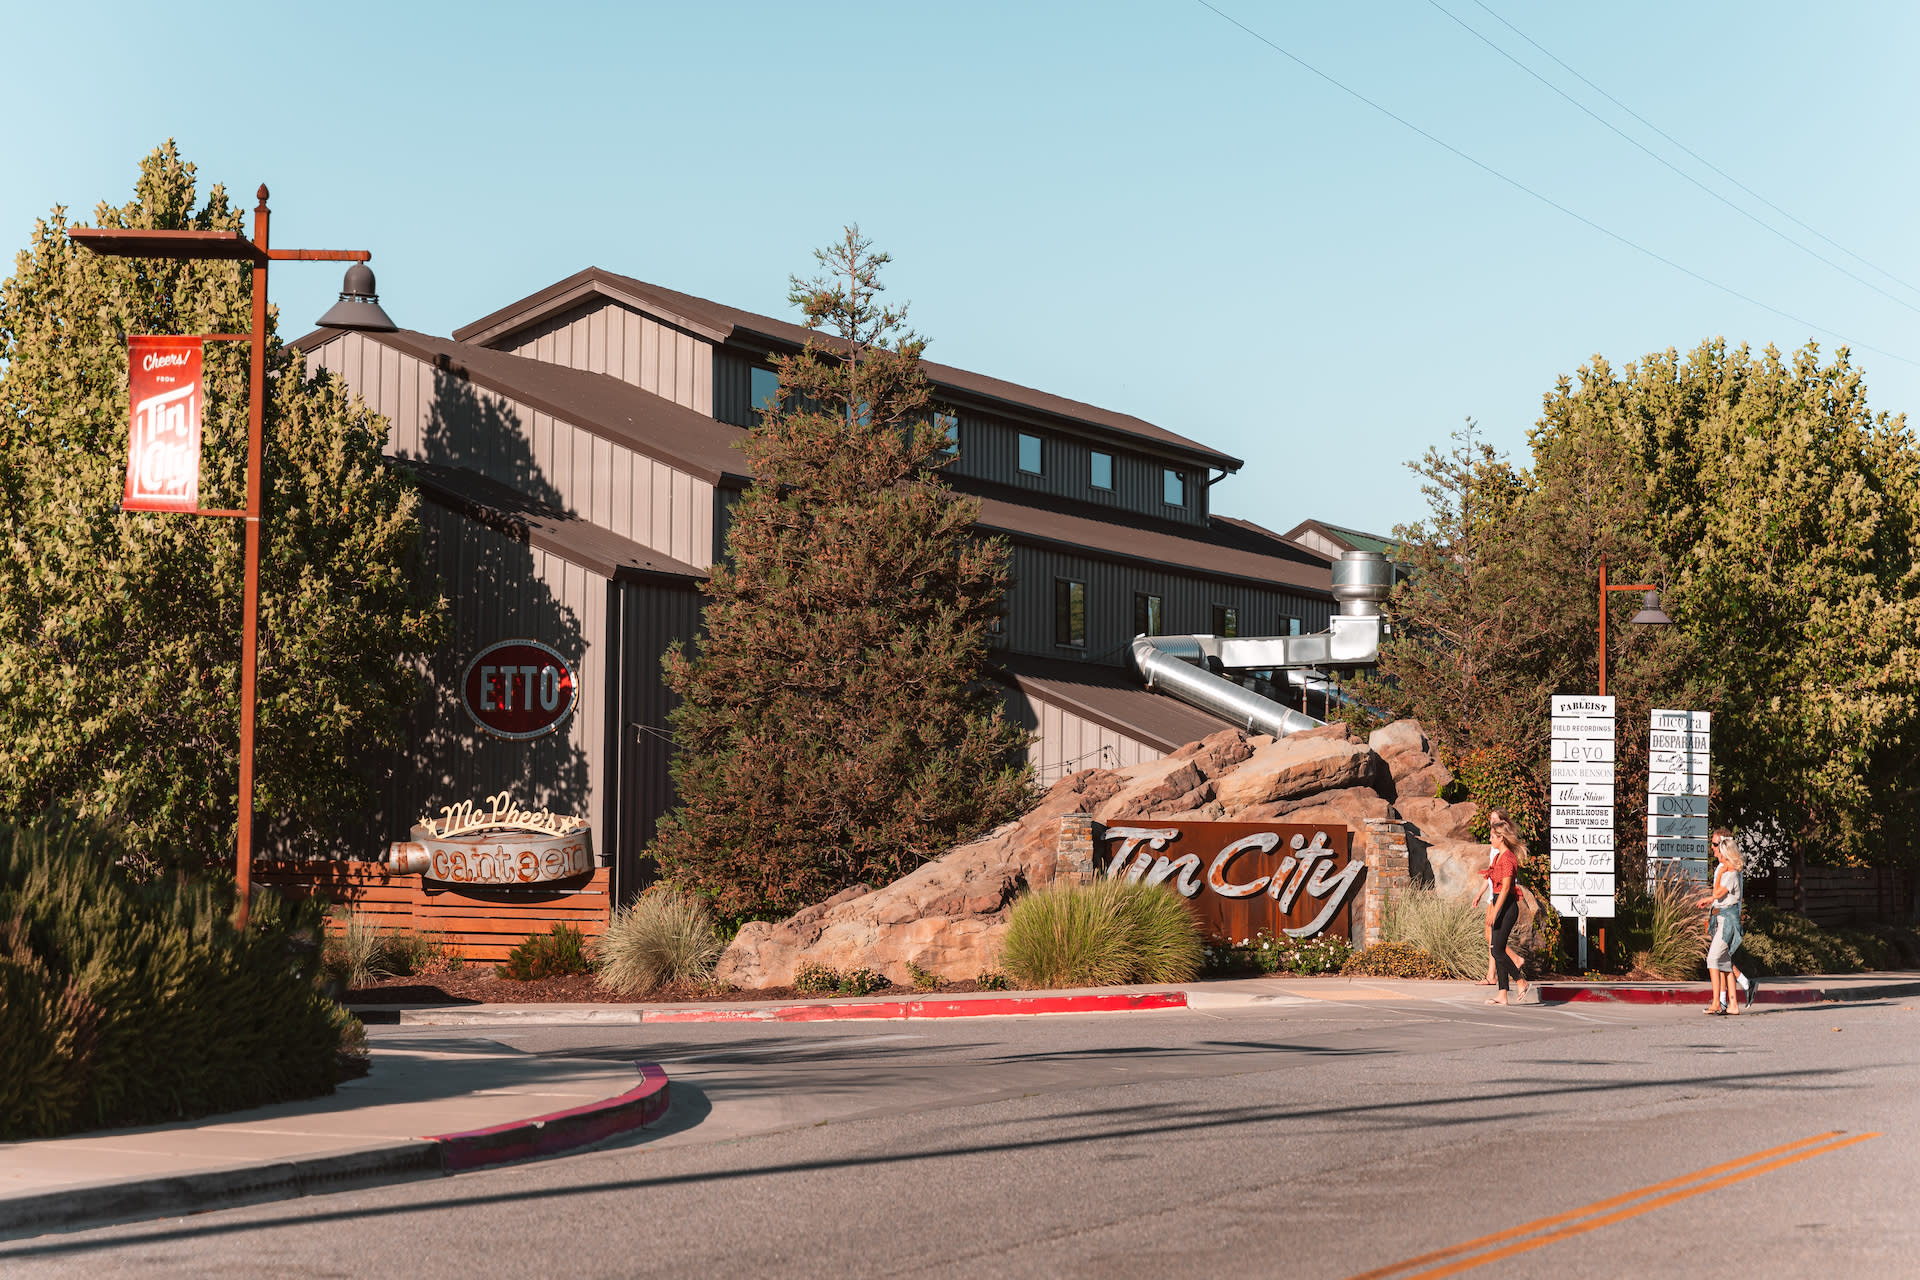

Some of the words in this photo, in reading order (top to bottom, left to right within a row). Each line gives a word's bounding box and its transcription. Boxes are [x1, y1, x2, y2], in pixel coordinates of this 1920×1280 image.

[143, 350, 191, 371] Cheers!
[136, 382, 194, 442] Tin
[480, 665, 559, 711] ETTO
[1560, 702, 1607, 712] FABLEIST
[1563, 741, 1603, 760] levo
[1652, 734, 1707, 750] DESPARADA
[1552, 768, 1577, 777] BRIAN
[1579, 768, 1613, 778] BENSON
[1651, 775, 1706, 793] Aaron
[1662, 797, 1694, 816] ONX
[1565, 818, 1599, 826] BREWING
[1552, 833, 1578, 845] SANS
[1582, 834, 1612, 845] LIEGE
[1660, 843, 1675, 852] CITY
[1676, 844, 1694, 853] CIDER
[432, 842, 592, 883] canteen
[1553, 852, 1586, 870] Jacob
[1588, 853, 1612, 866] Toft
[1105, 826, 1200, 898] Tin
[1207, 831, 1365, 938] City
